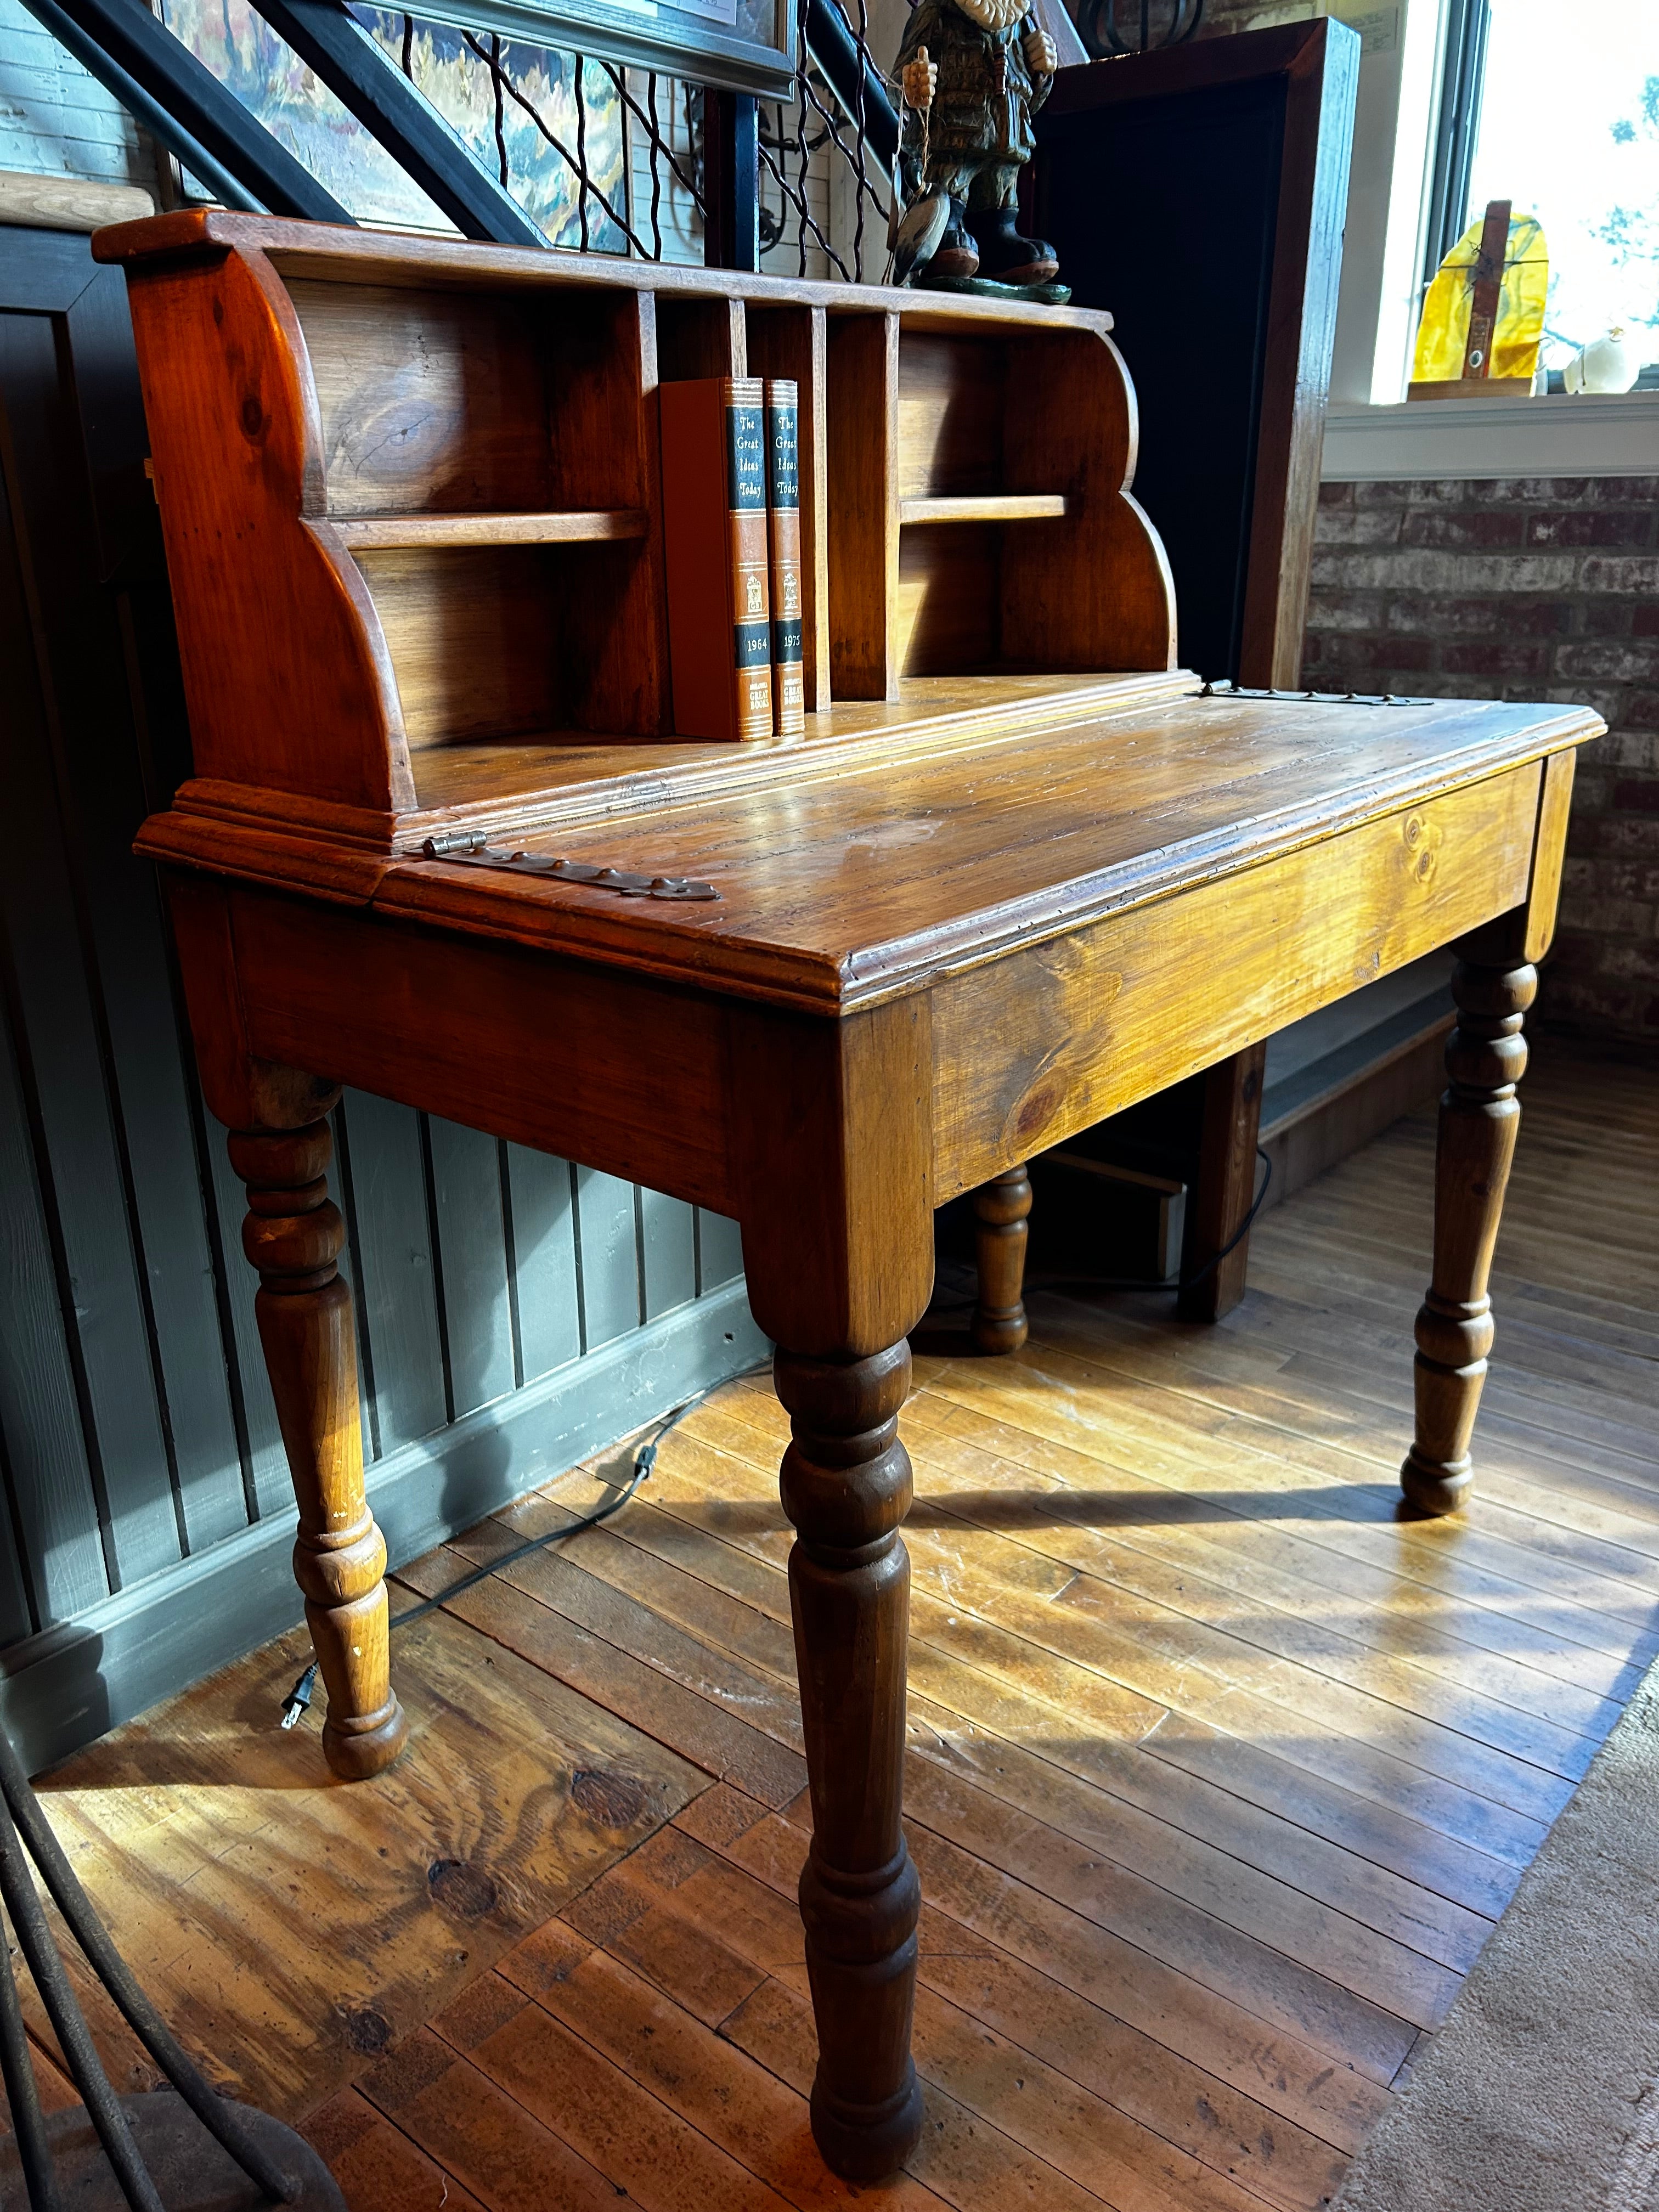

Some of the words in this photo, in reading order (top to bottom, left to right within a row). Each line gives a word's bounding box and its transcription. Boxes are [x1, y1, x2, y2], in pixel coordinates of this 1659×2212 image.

[740, 417, 754, 430] The
[778, 416, 794, 430] The
[737, 437, 758, 449] Great
[775, 437, 797, 448] Great
[740, 459, 759, 471] Ideas
[778, 458, 797, 470] Ideas
[740, 482, 761, 498] Today
[777, 482, 798, 497] Today
[747, 638, 767, 652] 1964
[784, 635, 800, 647] 1975
[749, 690, 769, 701] GREAT
[783, 686, 802, 696] GREAT
[750, 699, 770, 710] BOOKS
